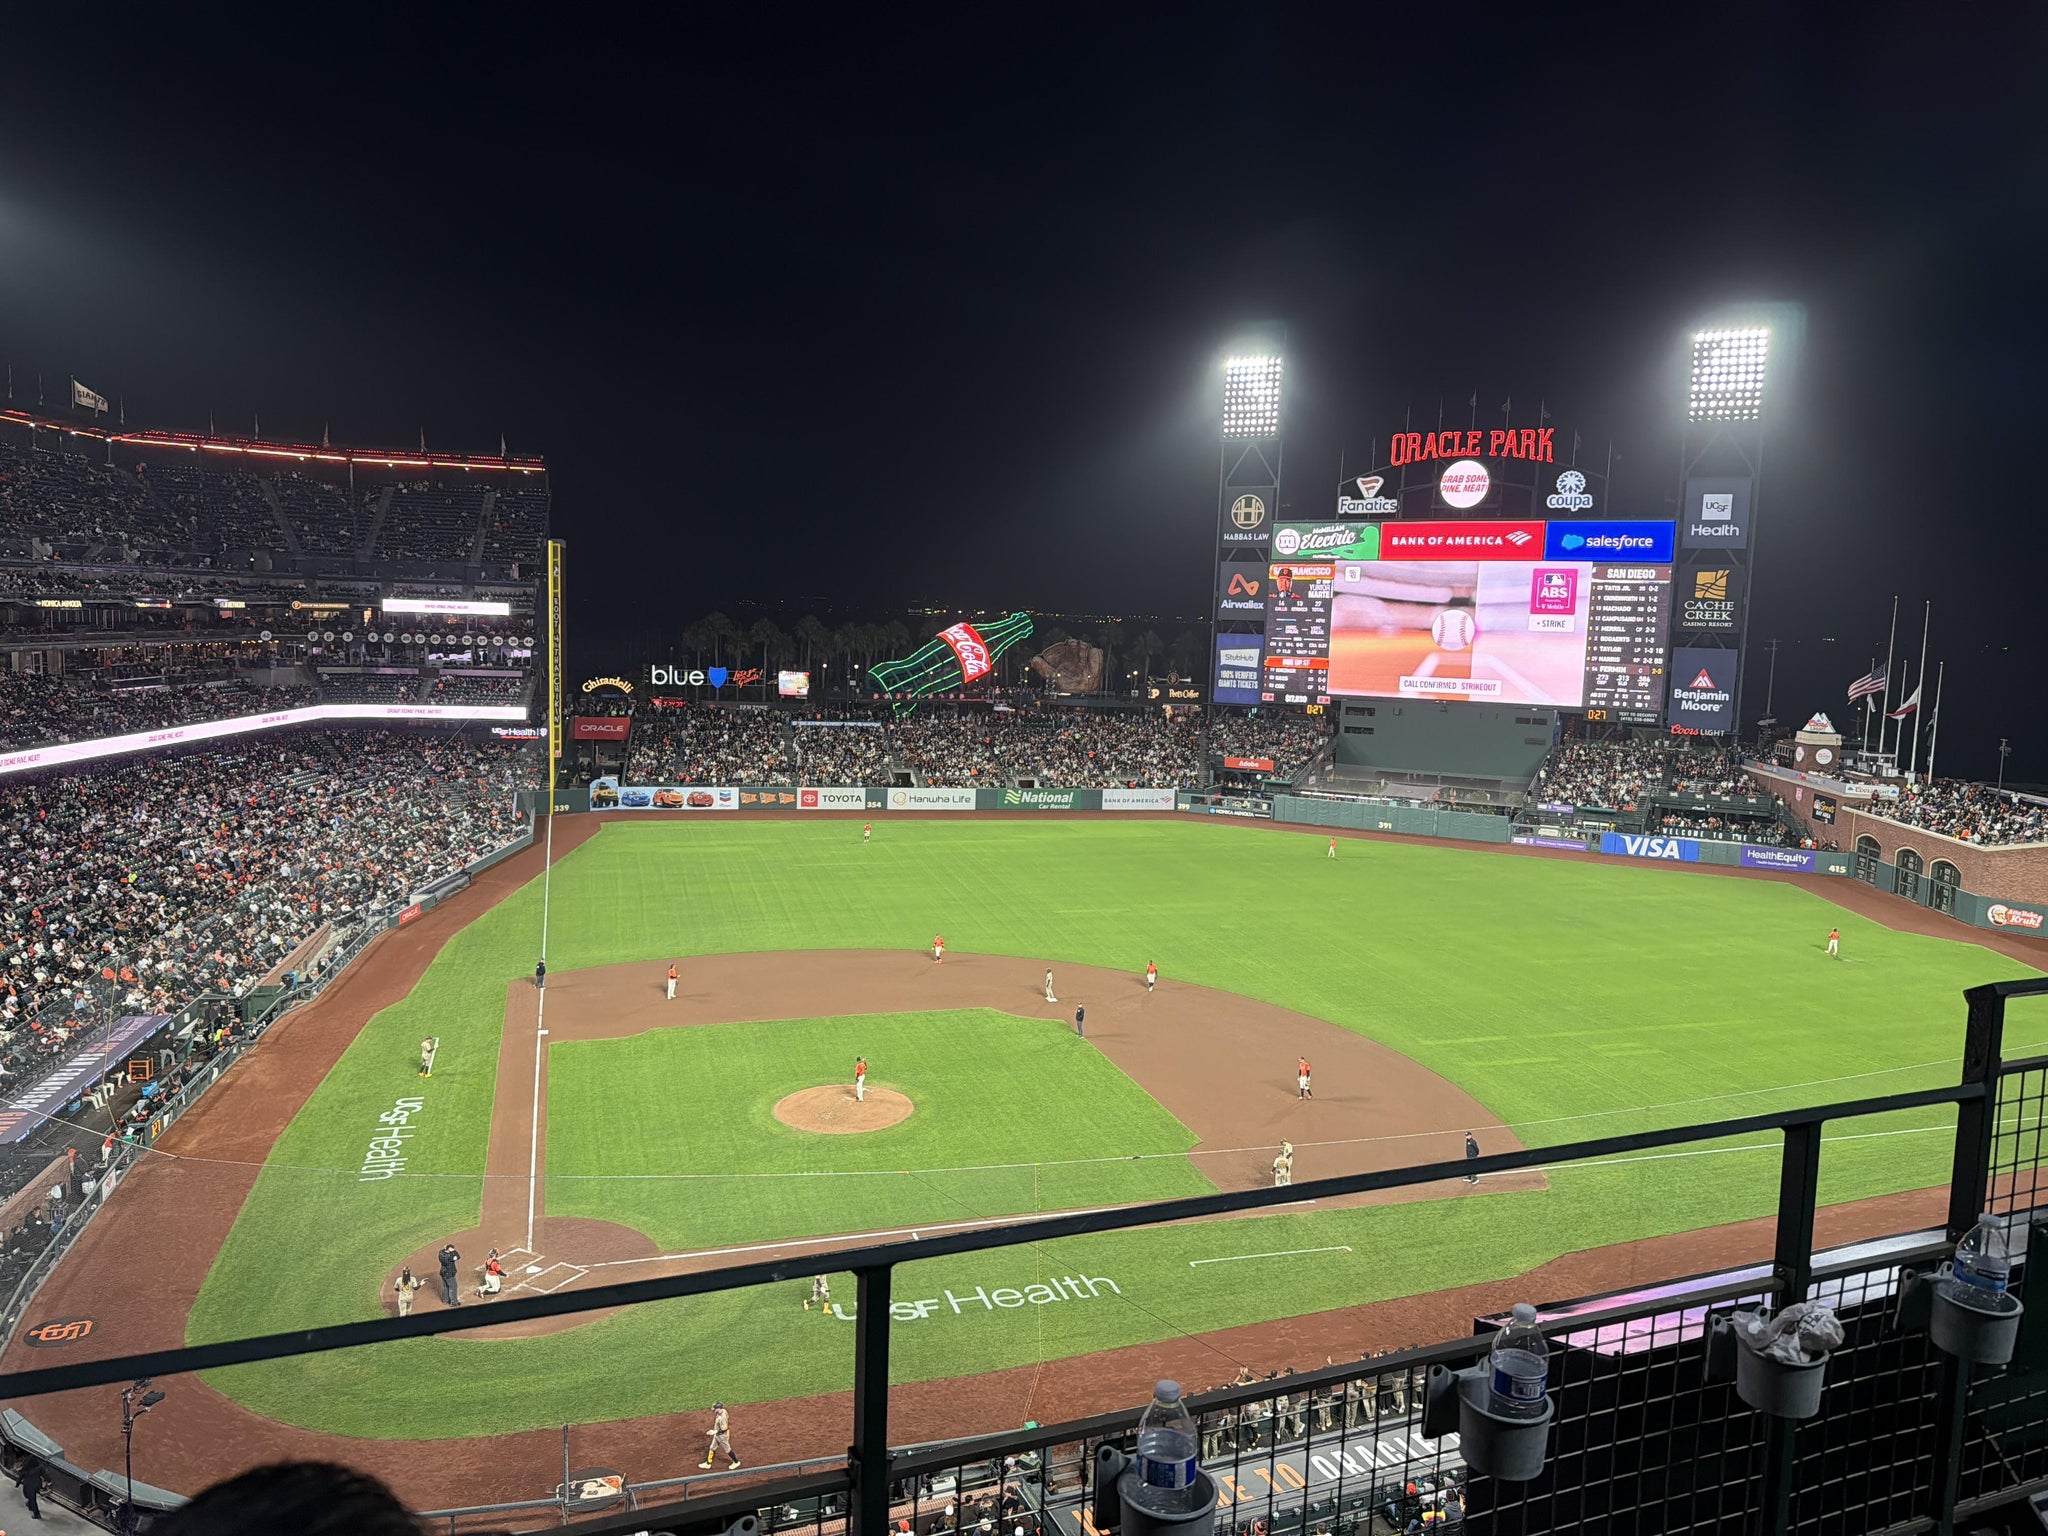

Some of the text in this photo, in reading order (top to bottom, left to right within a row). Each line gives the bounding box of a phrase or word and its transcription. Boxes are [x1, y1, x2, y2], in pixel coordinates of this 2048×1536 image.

[1391, 428, 1555, 466] ORACLE PARK
[1340, 500, 1397, 512] Fanatics
[1550, 495, 1590, 508] coupa
[1706, 502, 1728, 512] UCSF
[1691, 524, 1739, 536] Health
[1300, 532, 1356, 550] Electric
[1392, 536, 1502, 545] BANK OF AMERICA
[1586, 535, 1653, 550] salesforce
[1607, 569, 1656, 579] SAN DIEGO
[1540, 587, 1568, 598] ABS
[1221, 600, 1264, 610] Airwallex
[1684, 601, 1734, 610] CACHE
[1685, 611, 1731, 620] CREEK
[651, 665, 705, 686] blue
[1235, 671, 1257, 680] VERIFIED
[582, 676, 634, 694] Ghirardelli
[1218, 679, 1258, 689] GIANTS TICKETS
[1404, 680, 1496, 691] CALL CONFIRMED STRIKEOUT
[1182, 689, 1200, 699] Coffee
[1674, 689, 1729, 702] Benjamin
[1307, 705, 1323, 714] 0:27
[1588, 710, 1606, 720] 0:27
[1670, 724, 1699, 736] Coors
[1238, 760, 1260, 768] Adobe
[822, 794, 862, 803] TOYOTA
[909, 795, 971, 804] Hanwha Life
[1022, 792, 1073, 803] National
[1378, 821, 1392, 829] 391
[1662, 828, 1704, 838] WELCOME
[1732, 834, 1747, 842] THE
[1620, 836, 1680, 860] VISA
[1748, 849, 1808, 864] HealthEquity
[1829, 865, 1846, 873] 415
[358, 1096, 424, 1182] UCSF Health
[832, 1274, 1121, 1321] USF Health
[1253, 1463, 1307, 1492] TO
[1310, 1432, 1439, 1480] ORACLE
